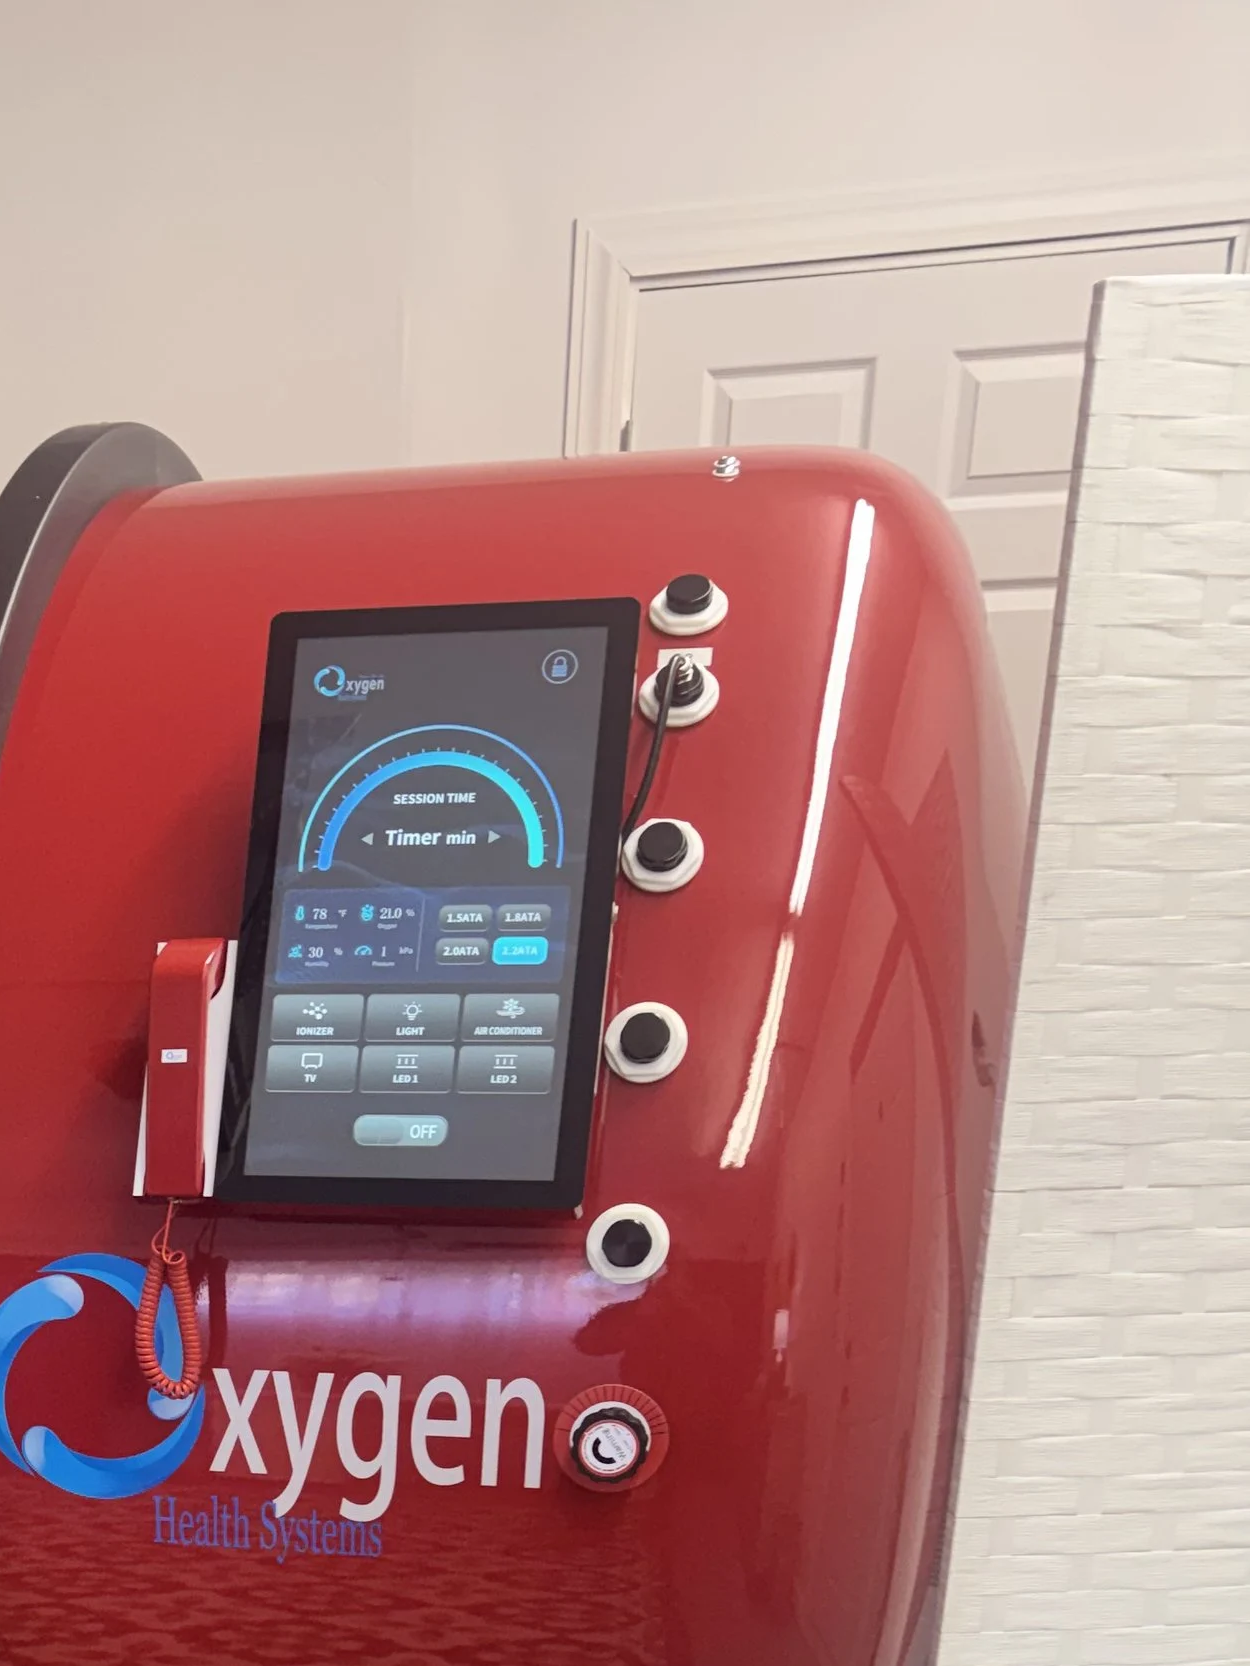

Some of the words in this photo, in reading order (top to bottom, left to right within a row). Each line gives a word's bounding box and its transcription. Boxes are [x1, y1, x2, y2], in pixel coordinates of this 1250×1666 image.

[393, 793, 445, 805] SESSION
[446, 792, 477, 803] TIME
[385, 828, 442, 846] Timer
[446, 830, 476, 845] min
[312, 908, 328, 920] 78
[379, 907, 402, 919] 21.0
[447, 913, 483, 922] 1.5ATA
[505, 912, 541, 922] 1.8ATA
[308, 946, 324, 958] 30
[381, 946, 387, 957] 1
[442, 946, 480, 956] 2.0ATA
[501, 946, 538, 956] 2.2ATA
[296, 1027, 334, 1036] IONIZER
[396, 1027, 425, 1036] LIGHT
[474, 1027, 489, 1036] AIR
[489, 1027, 543, 1036] CONDITIONER
[304, 1074, 317, 1083] TV
[392, 1074, 411, 1084] LED
[412, 1074, 418, 1084] 1
[490, 1074, 509, 1084] LED
[510, 1074, 517, 1084] 2
[409, 1125, 437, 1139] OFF
[152, 1495, 251, 1548] Health
[259, 1500, 383, 1563] Systems
